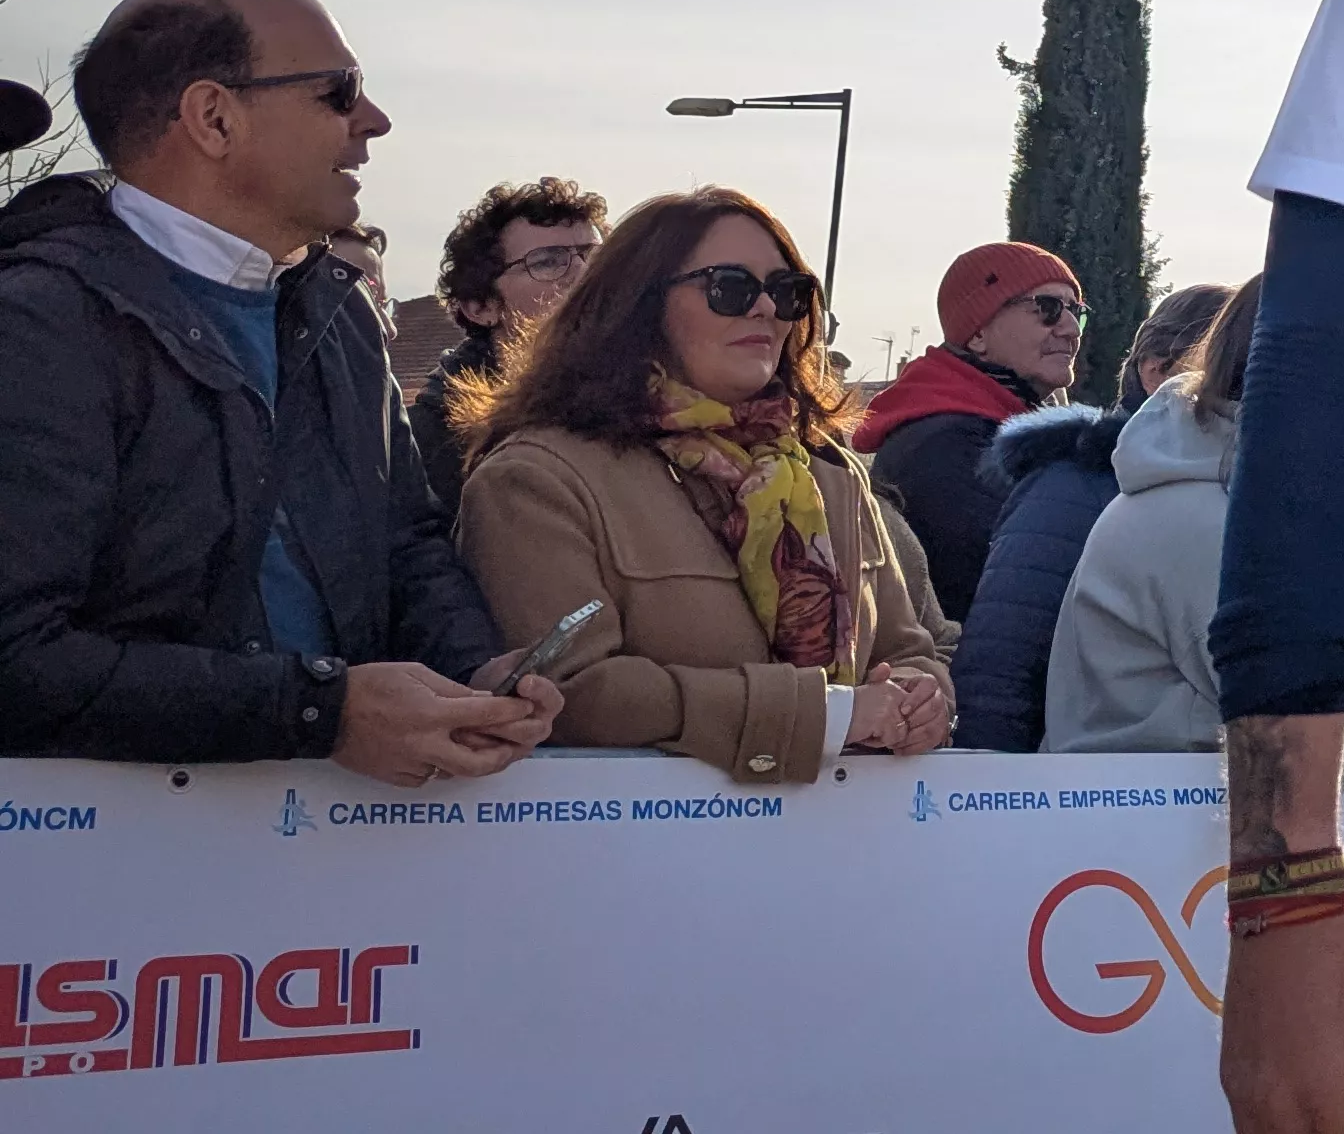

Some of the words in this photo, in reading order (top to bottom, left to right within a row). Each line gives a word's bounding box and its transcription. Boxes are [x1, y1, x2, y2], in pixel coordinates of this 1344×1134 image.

[329, 802, 465, 826] CARRERA
[476, 799, 623, 823] EMPRESAS
[632, 792, 783, 821] MONZÓNCM
[948, 790, 1051, 812] CARRERA
[1059, 788, 1167, 809] EMPRESAS
